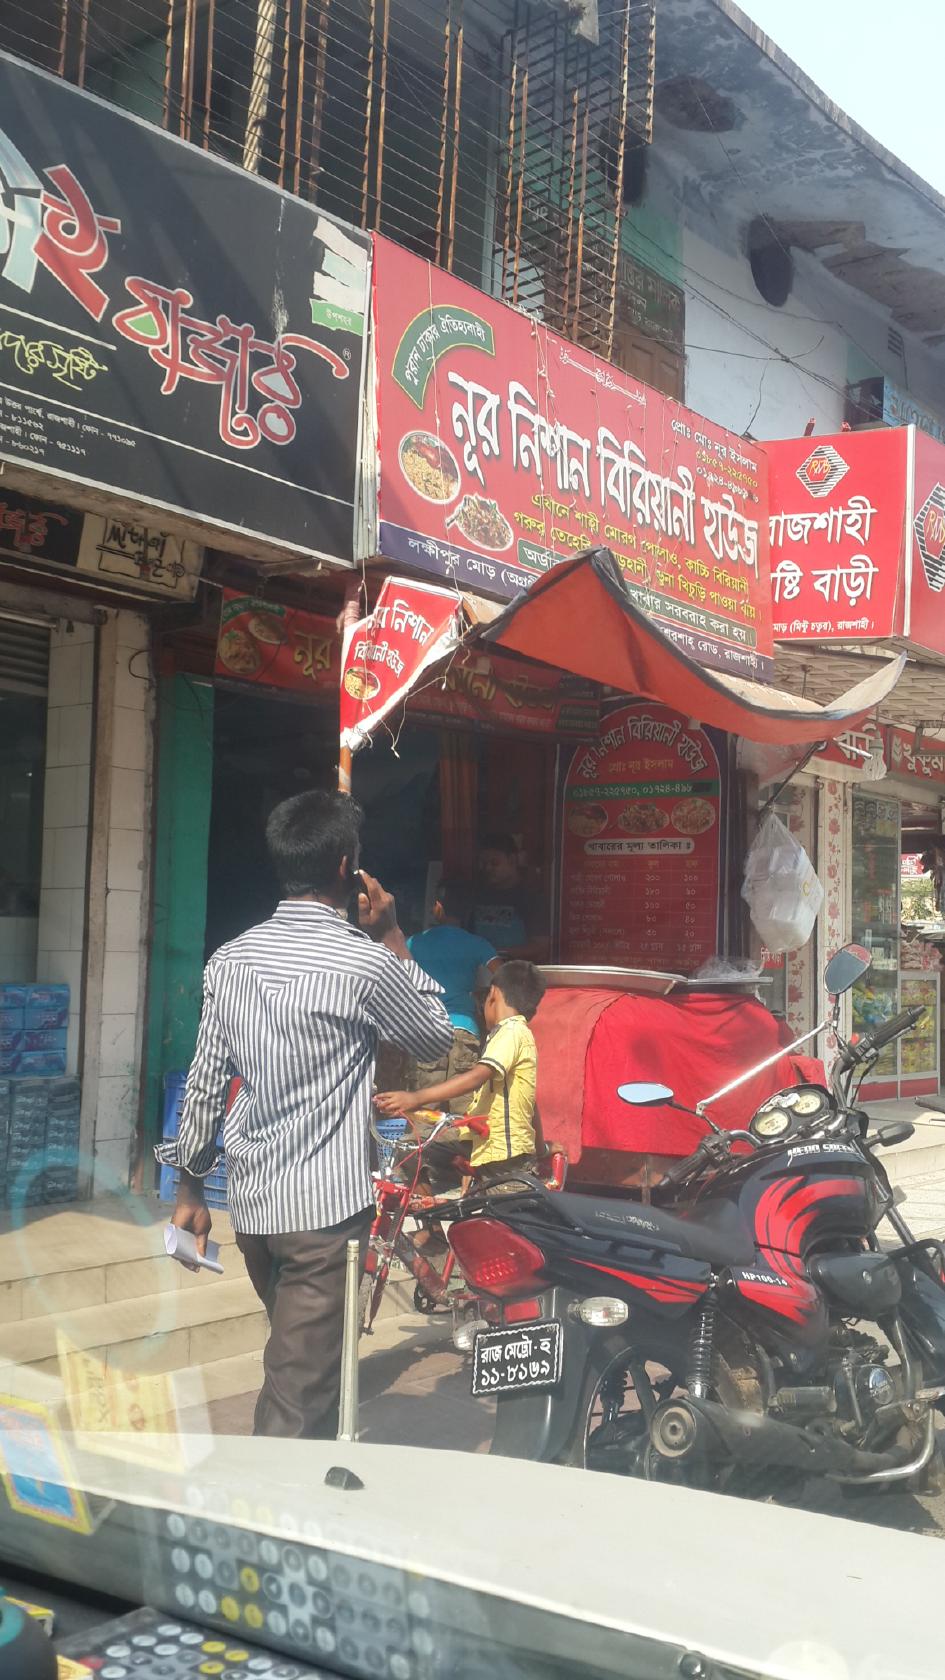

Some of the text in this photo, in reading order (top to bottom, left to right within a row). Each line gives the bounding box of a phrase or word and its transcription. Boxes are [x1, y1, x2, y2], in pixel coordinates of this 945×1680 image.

[447, 370, 501, 486] নূর
[508, 380, 591, 497] নিশান
[597, 426, 696, 546] বিরিয়ানী
[701, 493, 760, 579] হাউজ
[532, 494, 570, 520] এখানে
[604, 525, 637, 550] মোরগ
[466, 559, 496, 580] মোড়
[770, 554, 879, 607] ষ্টি বাড়ী
[391, 599, 435, 647] নিশান
[481, 1345, 502, 1364] রাজ
